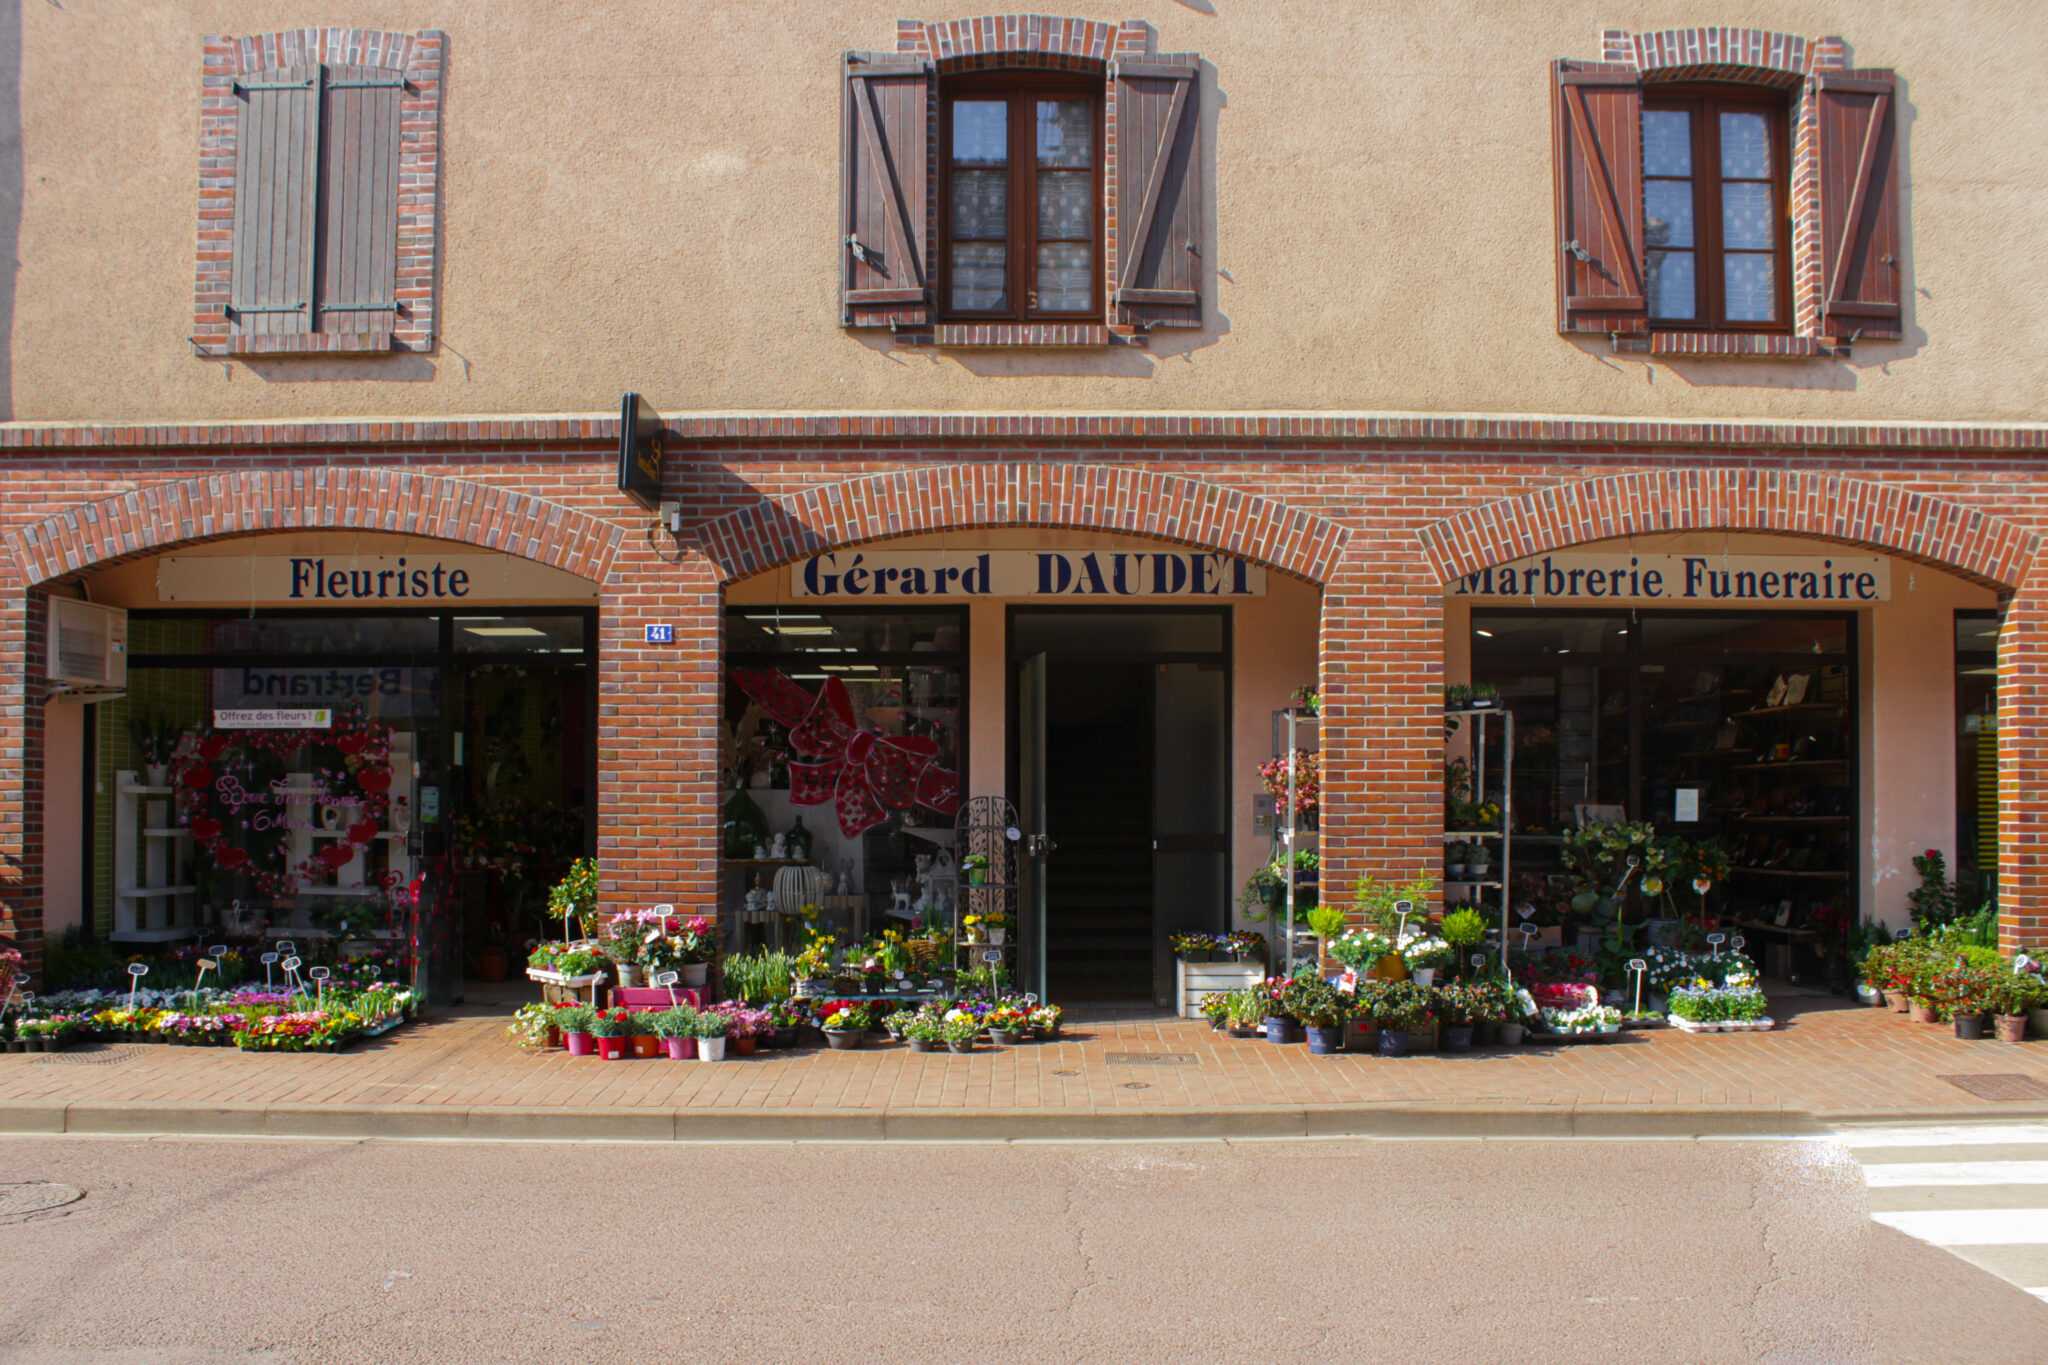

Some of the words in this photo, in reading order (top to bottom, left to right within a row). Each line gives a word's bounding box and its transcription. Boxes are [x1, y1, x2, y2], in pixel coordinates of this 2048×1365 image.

[289, 558, 470, 599] Fleuriste
[804, 553, 992, 596] Gérard
[1456, 557, 1663, 597] Marbrerie
[1682, 558, 1876, 599] Funeraire
[650, 624, 666, 640] 41
[219, 711, 252, 721] Offrez
[256, 711, 273, 721] des
